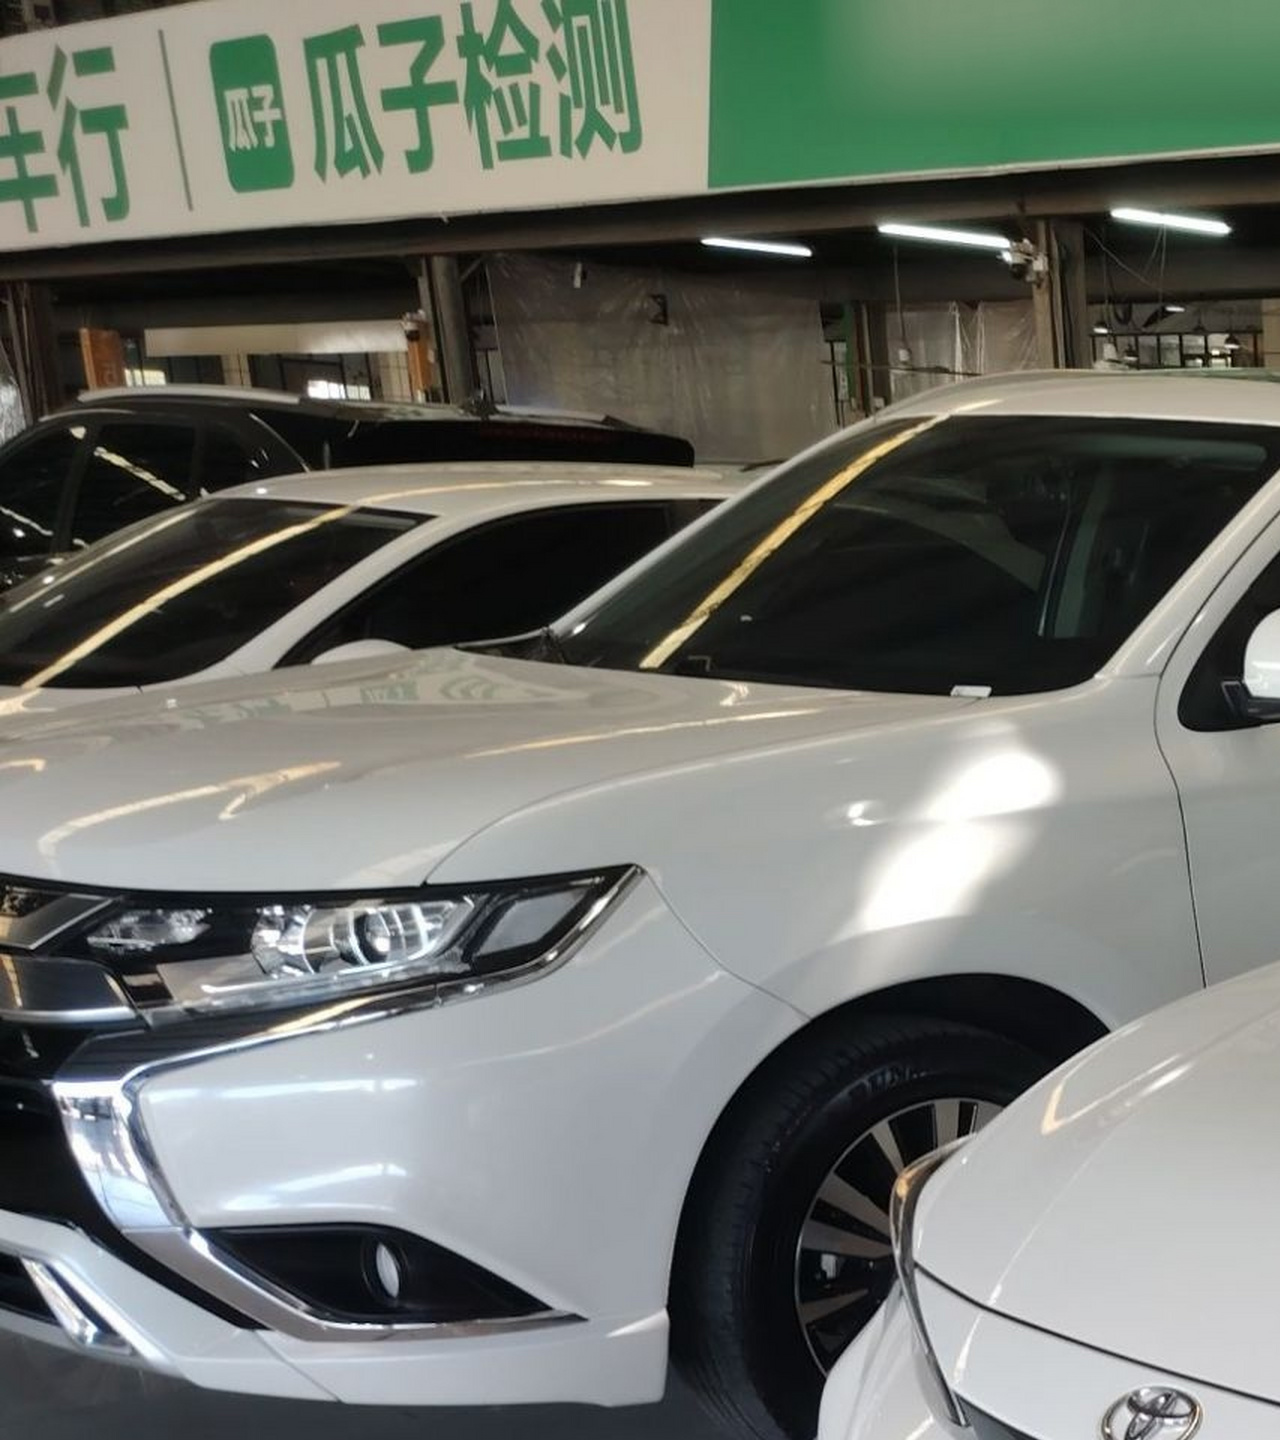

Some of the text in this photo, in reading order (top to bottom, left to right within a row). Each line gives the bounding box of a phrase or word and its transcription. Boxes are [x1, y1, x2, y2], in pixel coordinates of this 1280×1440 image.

[225, 83, 284, 154] 瓜子
[302, 0, 644, 184] 瓜子检测
